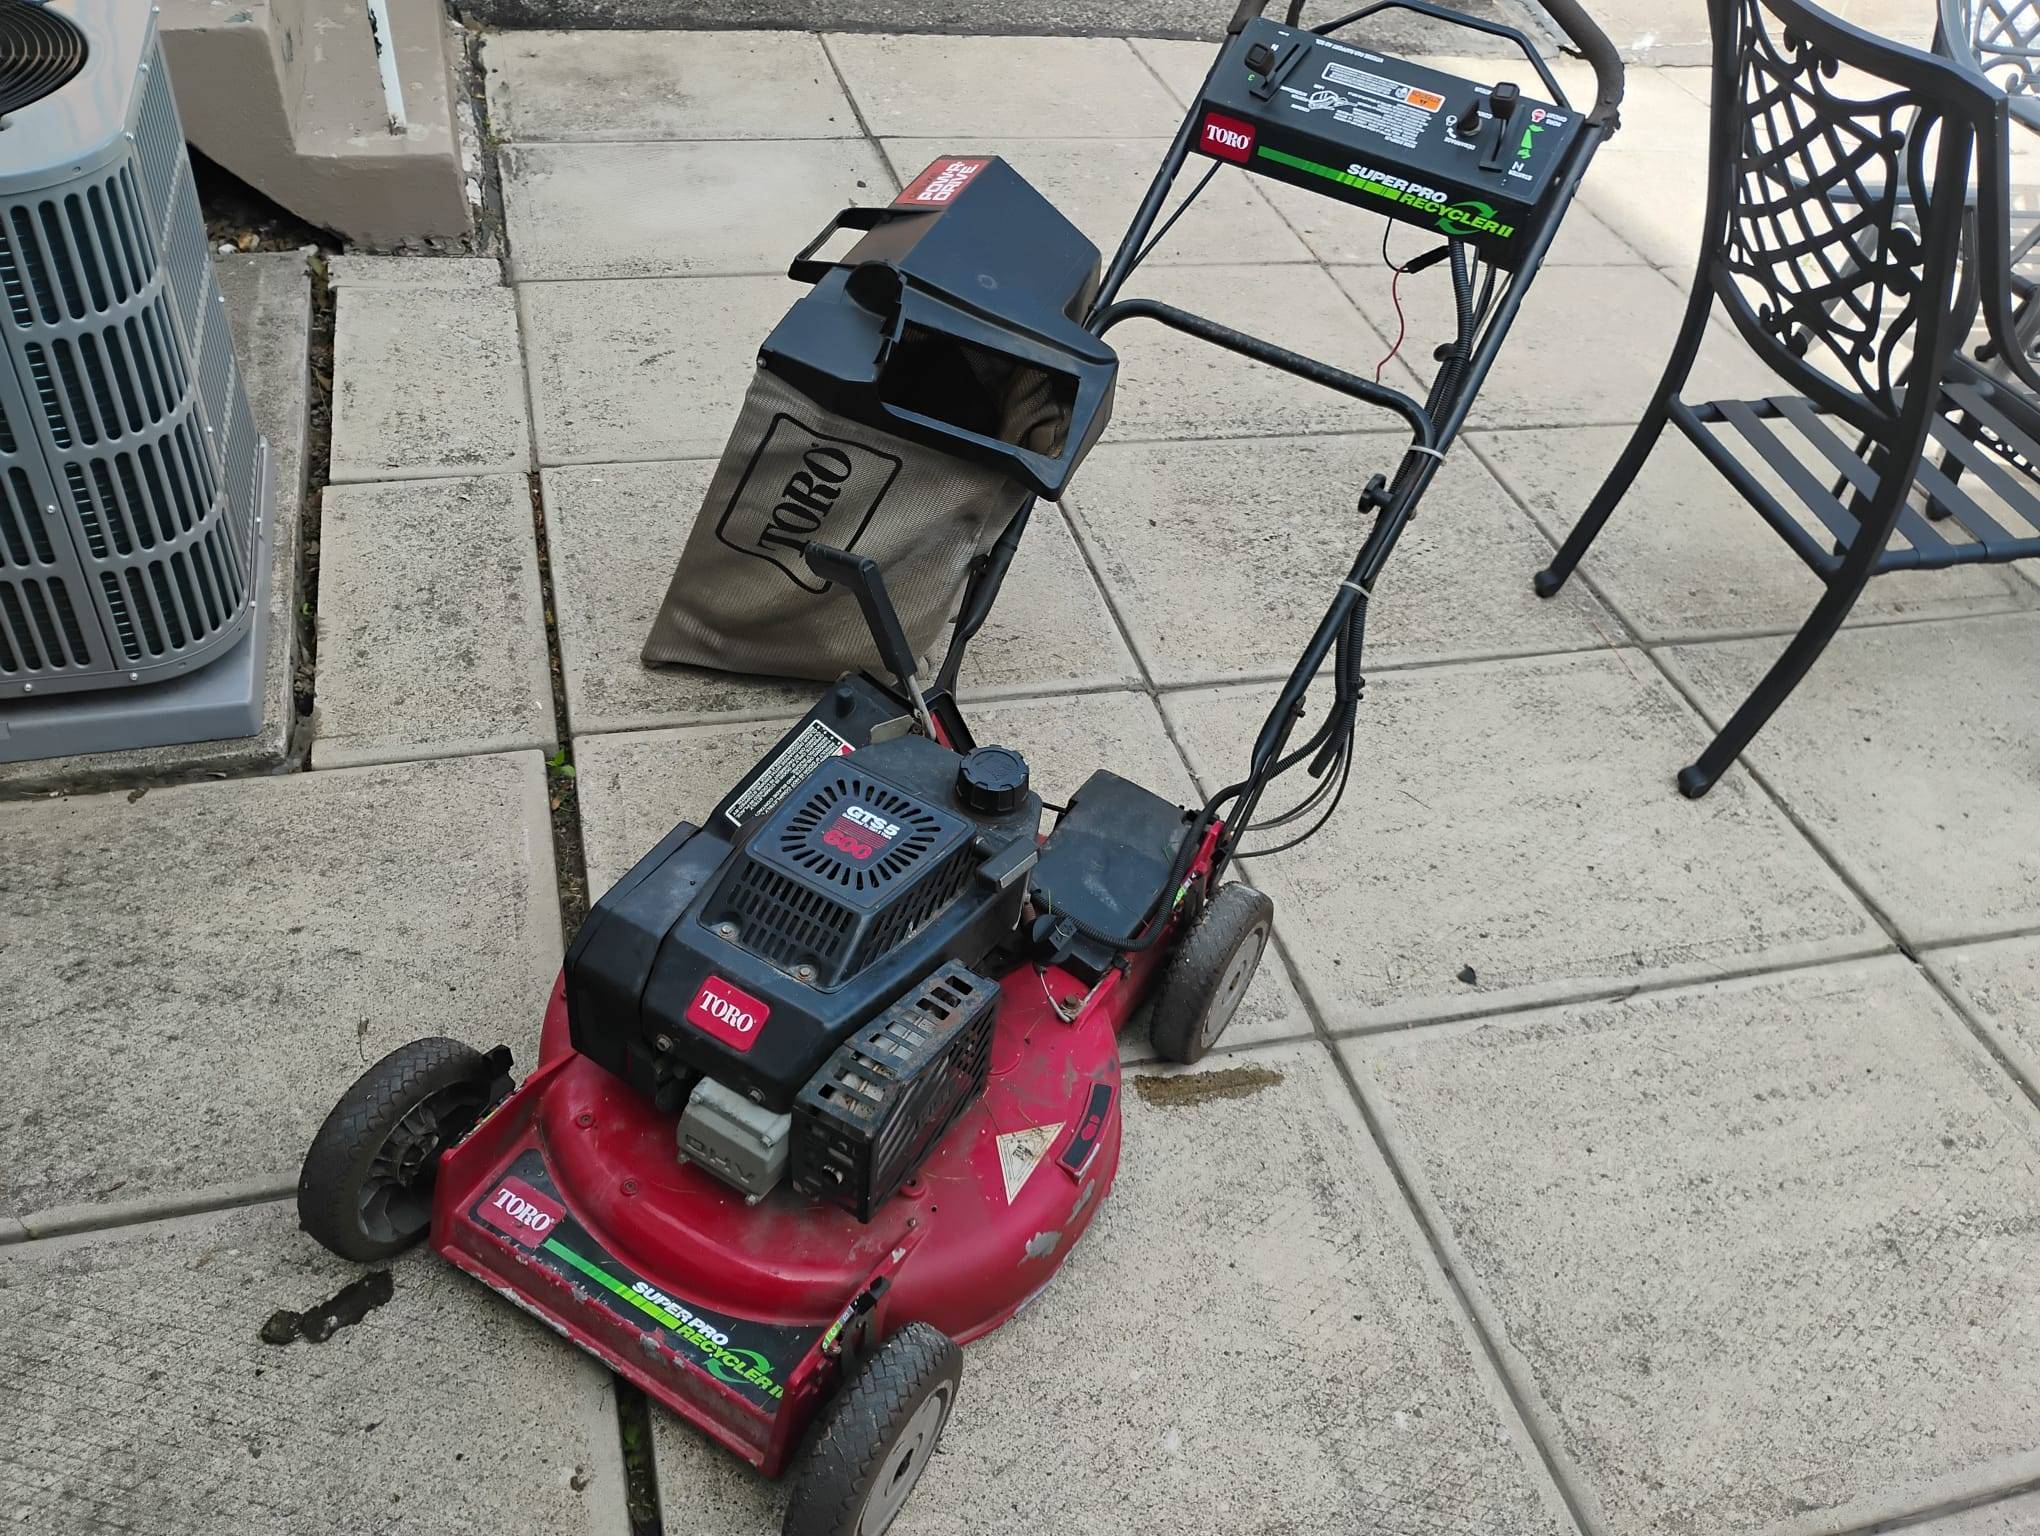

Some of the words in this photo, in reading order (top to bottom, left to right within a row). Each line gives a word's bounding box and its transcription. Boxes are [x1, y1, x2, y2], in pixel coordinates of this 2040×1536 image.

[1206, 124, 1250, 150] TORO
[1512, 161, 1525, 172] N
[1400, 194, 1500, 234] RECYCLER
[757, 446, 852, 558] TORO
[699, 990, 754, 1032] TORO
[493, 1188, 551, 1231] TORO
[676, 1325, 774, 1390] RECYCLER
